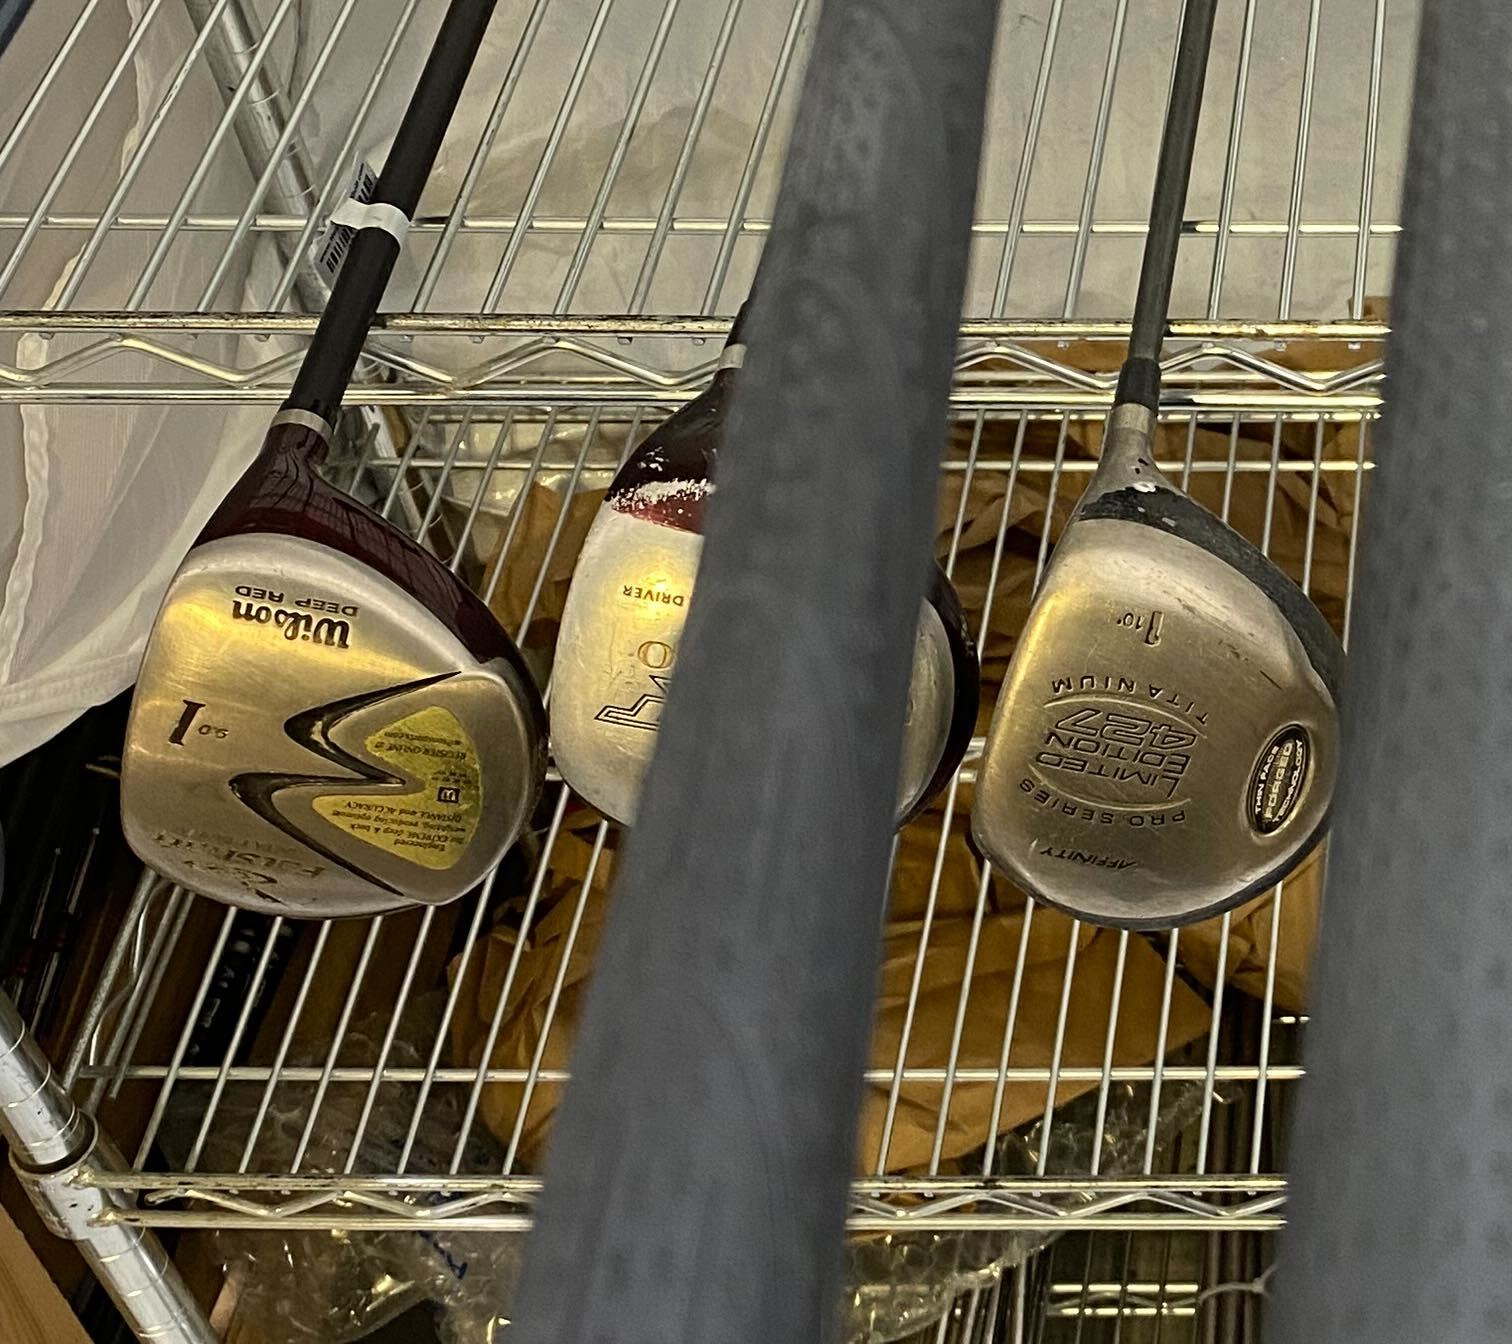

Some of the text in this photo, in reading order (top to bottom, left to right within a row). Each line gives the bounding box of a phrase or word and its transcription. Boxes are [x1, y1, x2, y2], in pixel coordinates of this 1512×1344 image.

[233, 583, 359, 618] DEEP RED
[622, 584, 685, 608] DRIVER
[231, 599, 350, 650] Wilson
[1143, 610, 1165, 648] 1
[1051, 674, 1209, 726] TITANIUM
[1054, 707, 1197, 751] 427
[1254, 783, 1265, 810] THIN
[1263, 742, 1293, 817] FORGED
[1271, 739, 1303, 822] TECHNOLOGY
[345, 800, 397, 815] ACCURACY
[1018, 777, 1186, 828] PRO SERIES
[1040, 846, 1137, 871] AFFINITY
